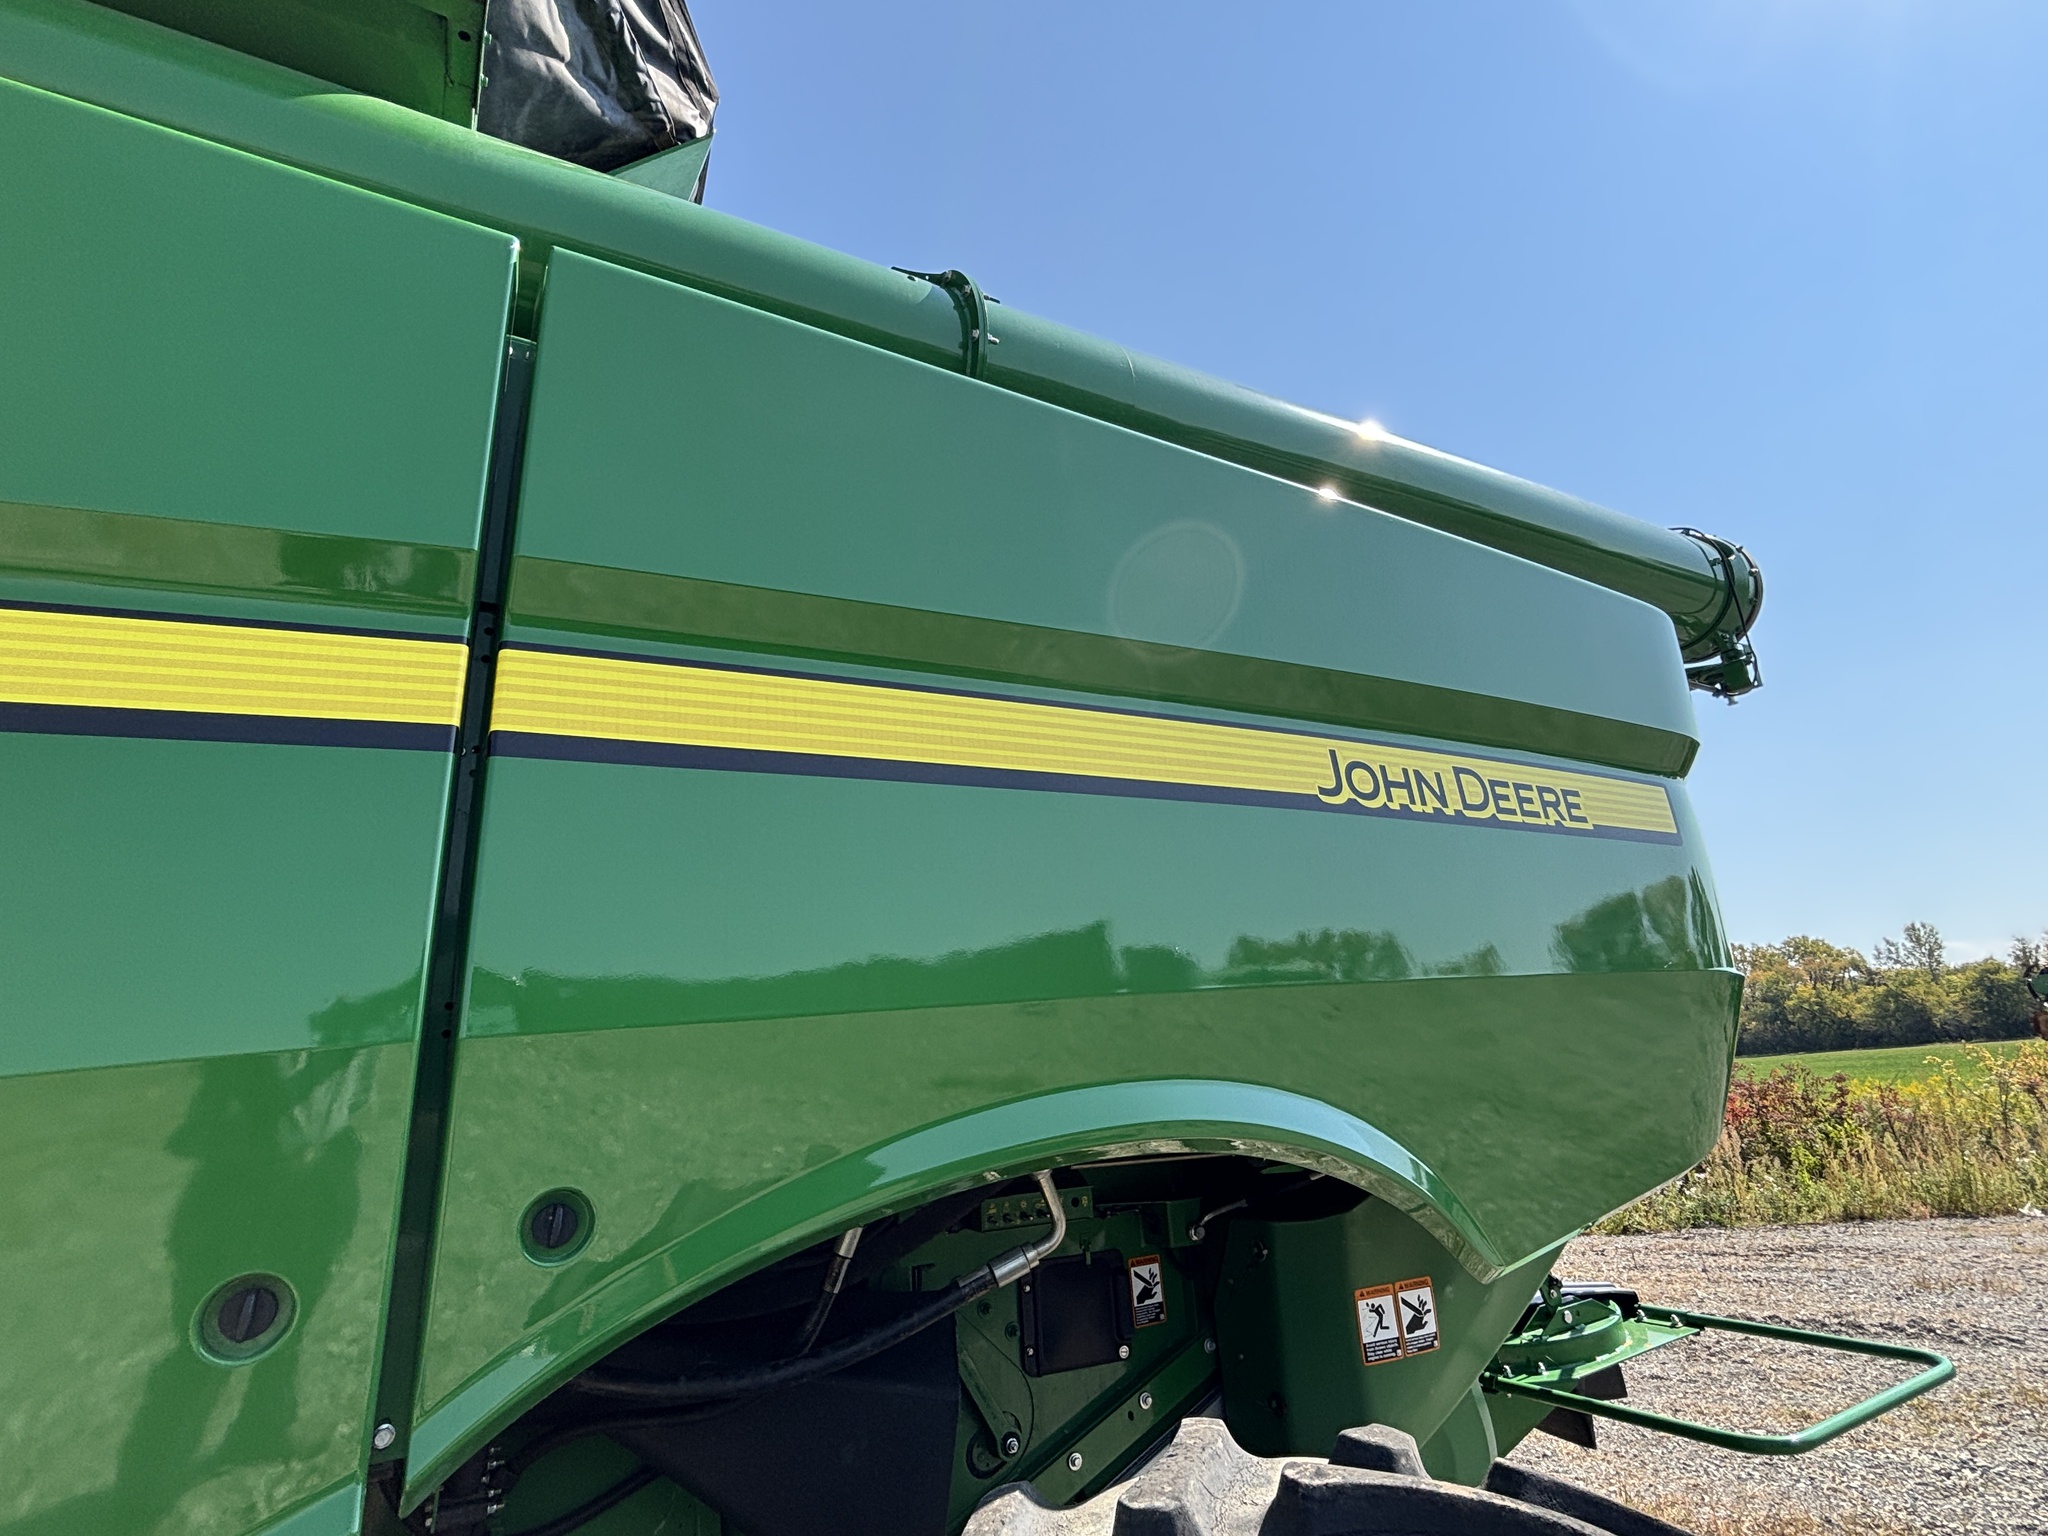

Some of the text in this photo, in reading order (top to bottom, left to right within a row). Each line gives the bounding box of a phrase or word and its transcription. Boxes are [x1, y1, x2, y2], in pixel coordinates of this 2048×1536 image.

[1317, 748, 1589, 824] JOHN DEERE
[1404, 1279, 1428, 1288] WARNING
[1366, 1287, 1390, 1295] WARNING
